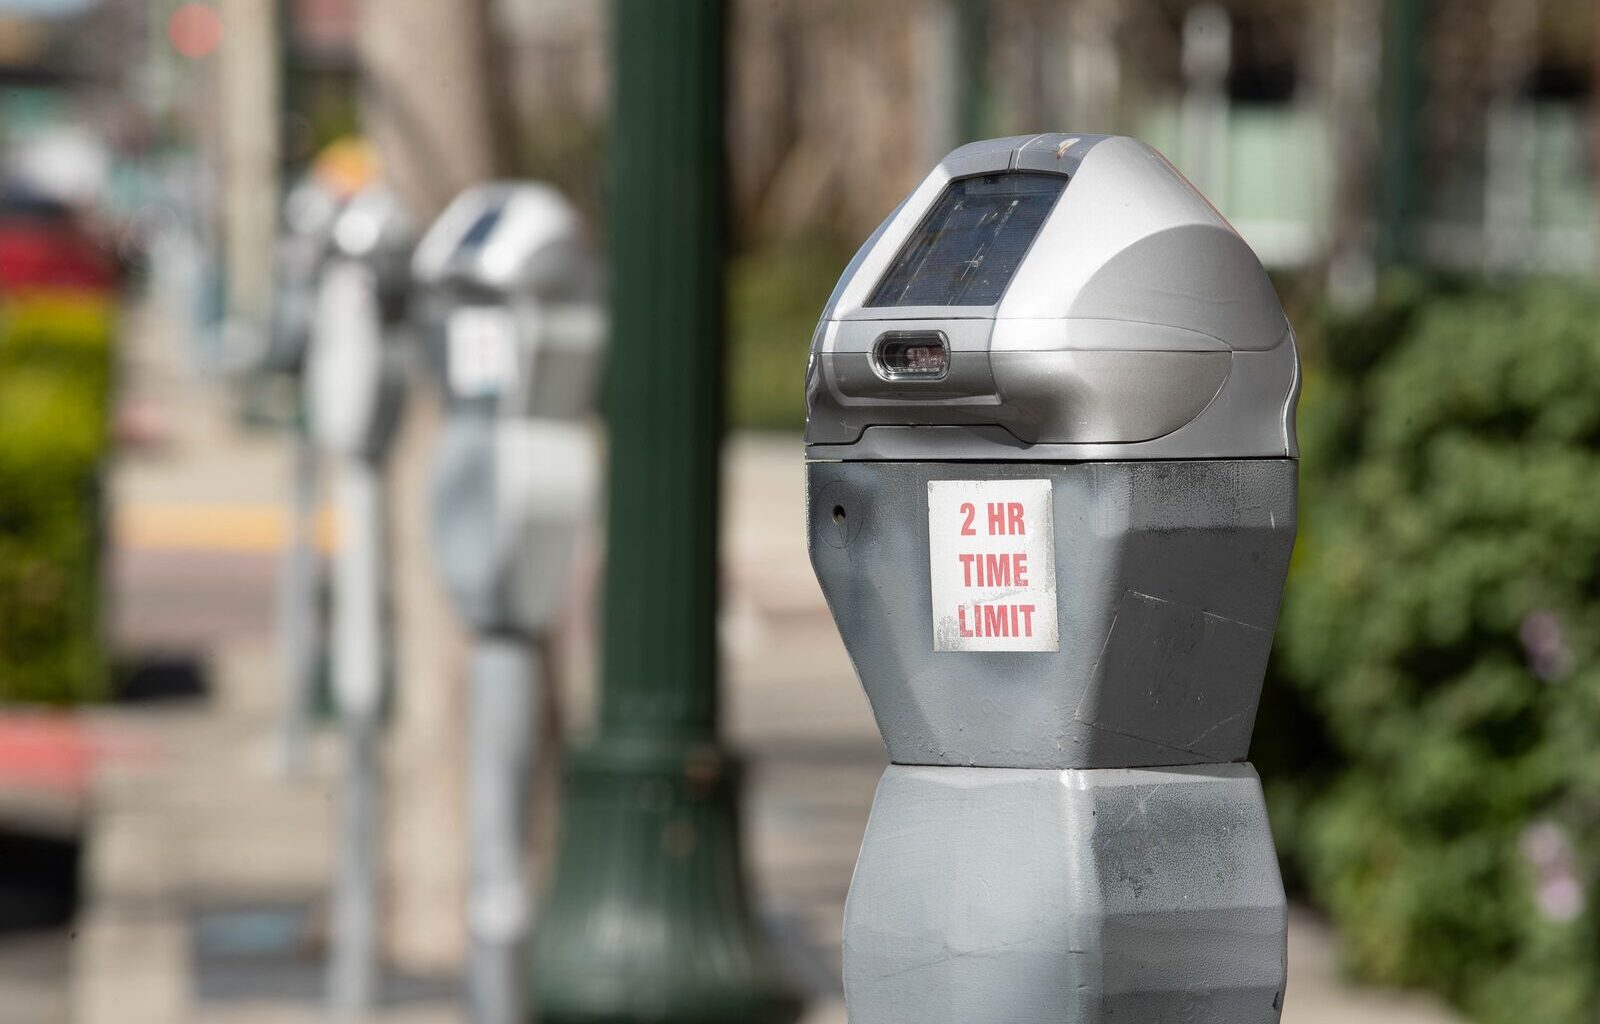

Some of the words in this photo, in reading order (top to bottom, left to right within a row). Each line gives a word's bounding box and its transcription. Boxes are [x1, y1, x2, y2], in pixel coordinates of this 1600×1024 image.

[959, 502, 977, 536] 2
[987, 502, 1026, 536] HR
[959, 553, 1029, 587] TIME
[958, 604, 1036, 638] LIMIT
